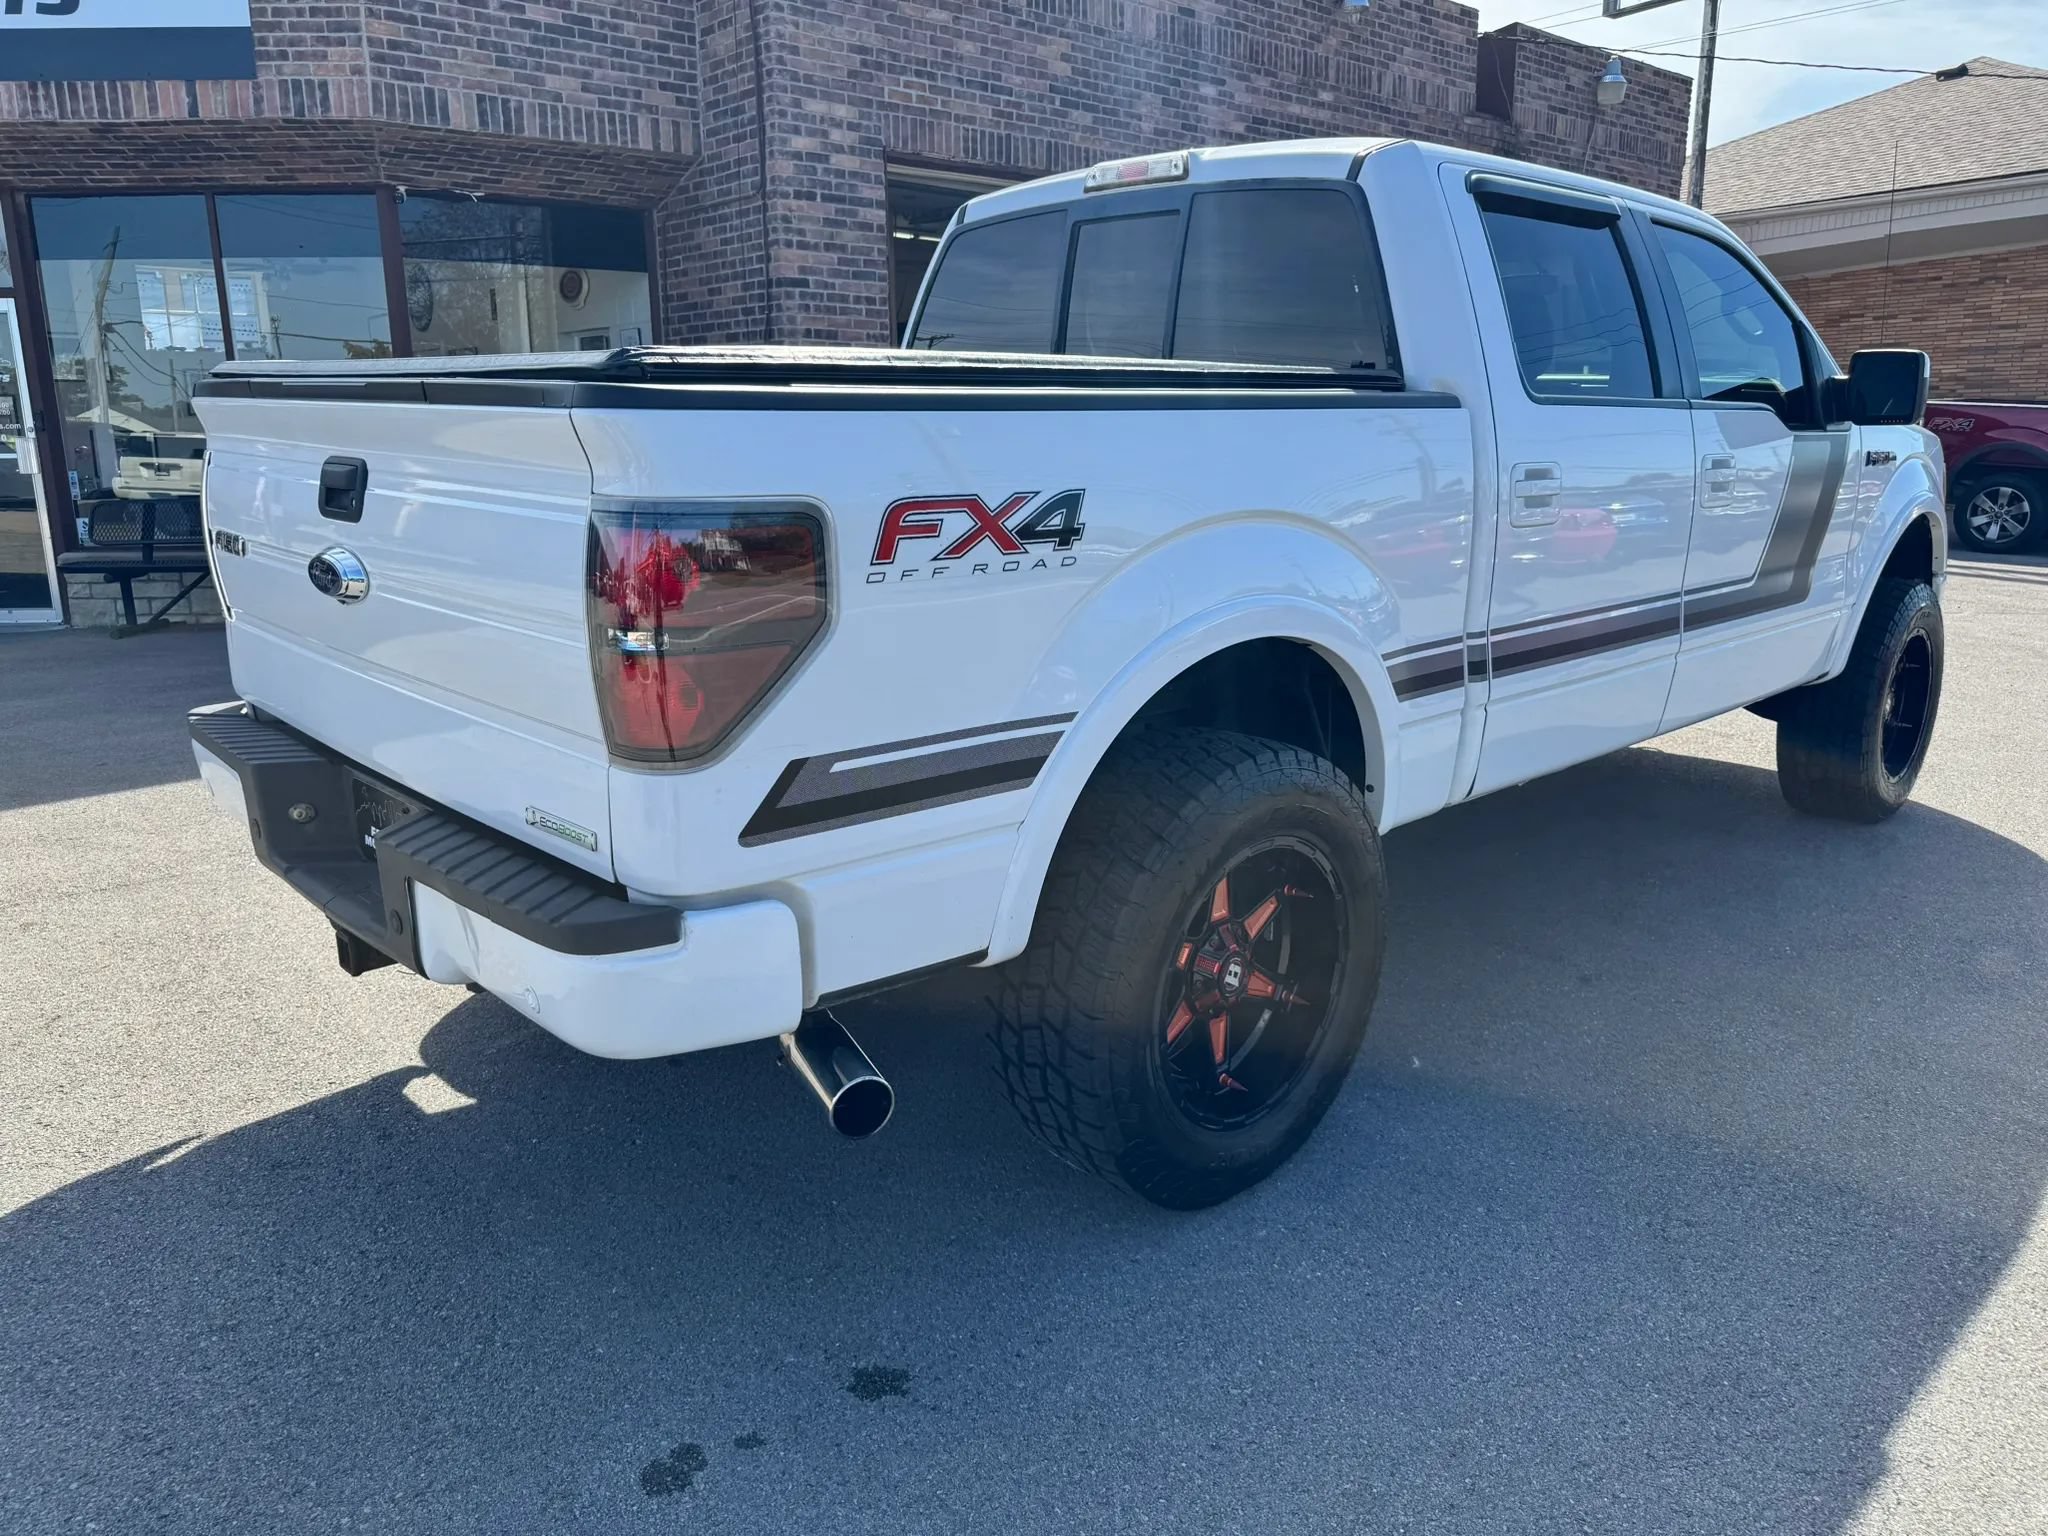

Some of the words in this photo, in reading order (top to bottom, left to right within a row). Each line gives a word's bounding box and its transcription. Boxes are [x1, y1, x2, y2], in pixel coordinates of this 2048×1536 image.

[1928, 417, 1975, 430] FX4
[870, 488, 1086, 566] FX4
[865, 566, 950, 584] OFF
[972, 555, 1078, 575] ROAD
